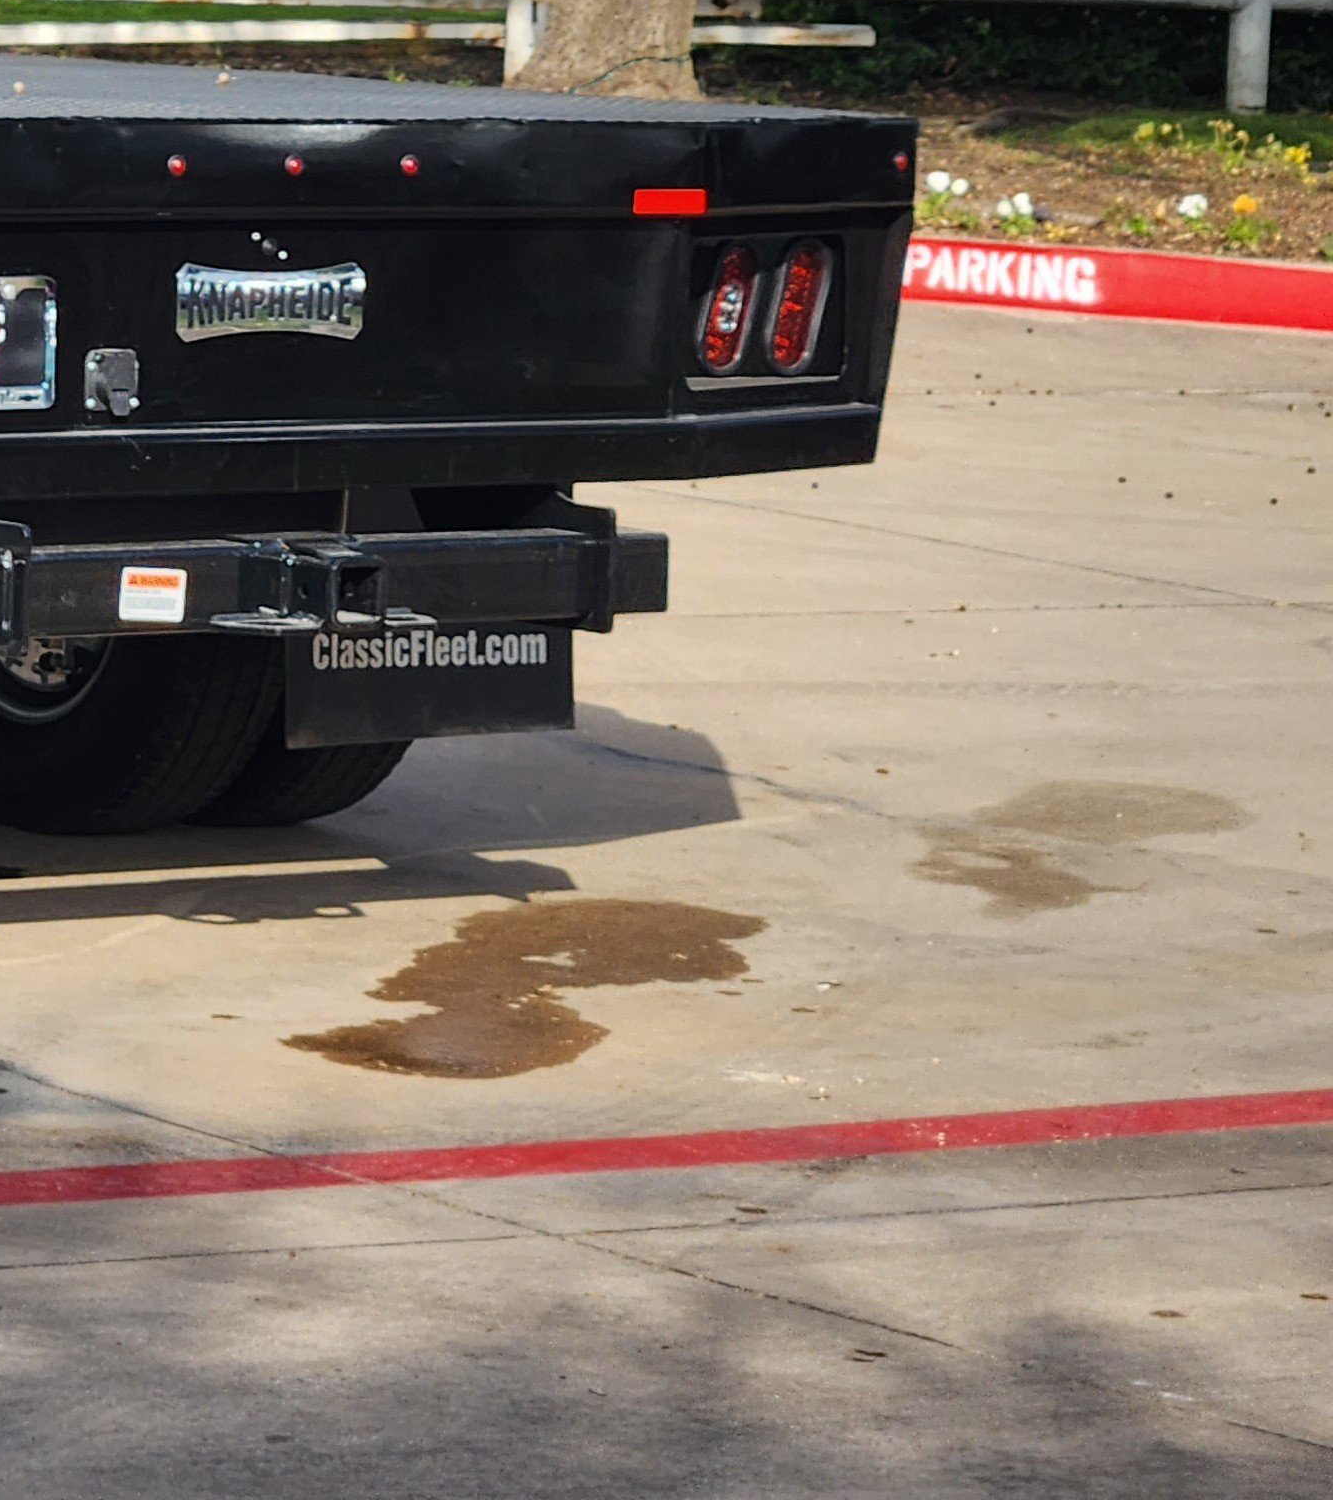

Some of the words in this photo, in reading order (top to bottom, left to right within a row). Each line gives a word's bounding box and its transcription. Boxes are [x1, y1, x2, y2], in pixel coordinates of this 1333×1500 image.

[902, 244, 1098, 305] PARKING
[187, 277, 352, 328] KNAPHEIDE
[312, 629, 548, 670] ClassicFleet.com
